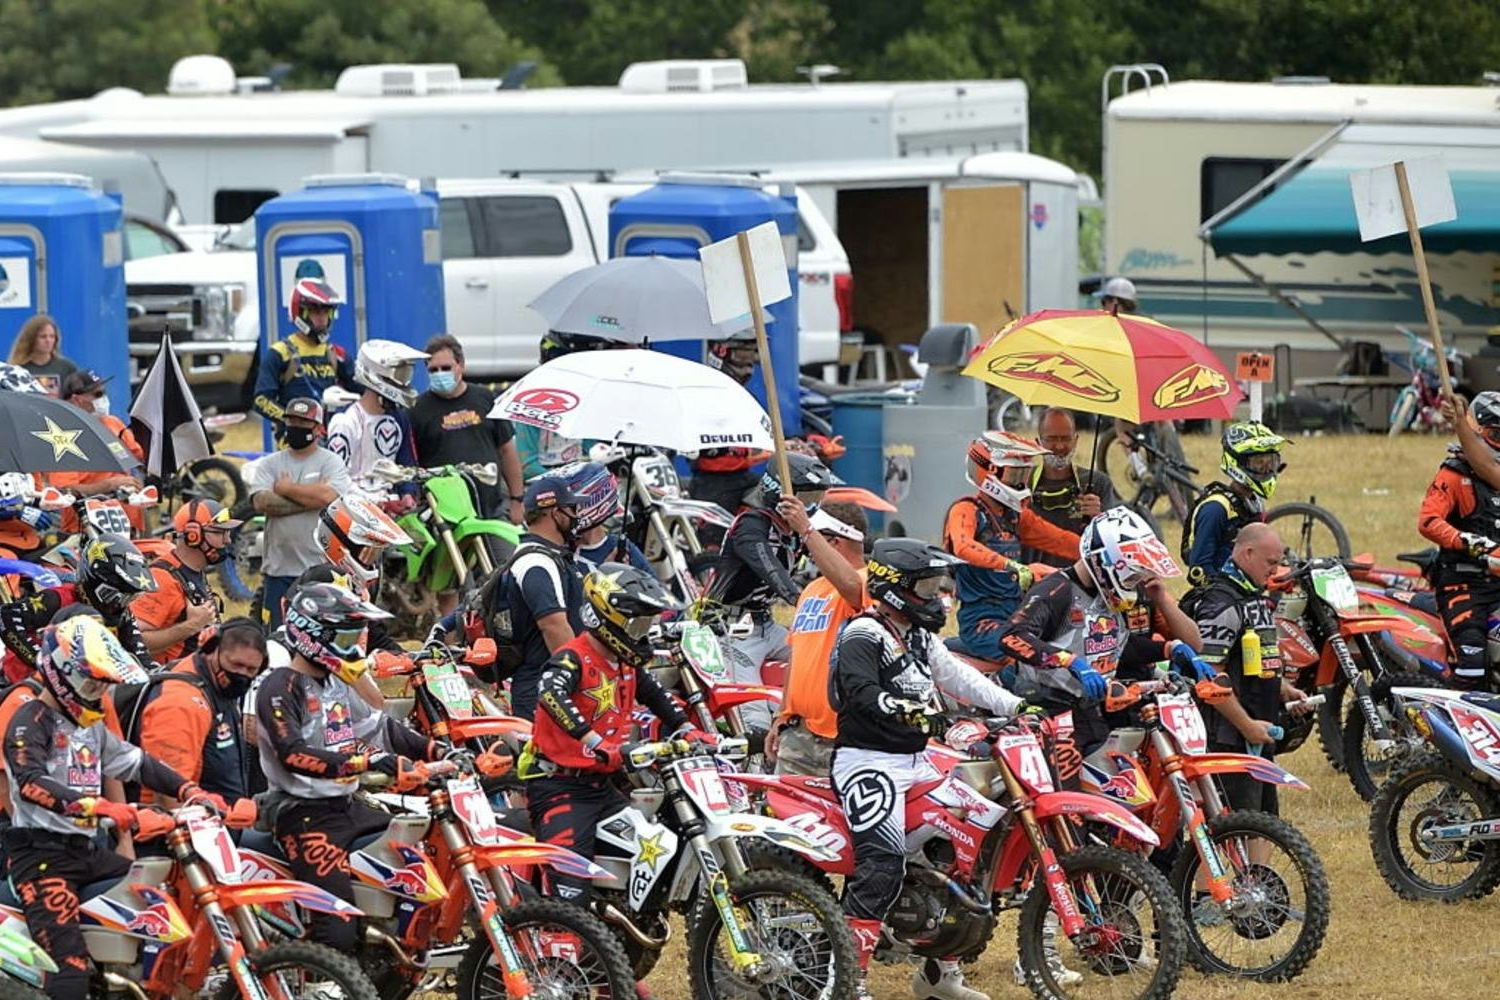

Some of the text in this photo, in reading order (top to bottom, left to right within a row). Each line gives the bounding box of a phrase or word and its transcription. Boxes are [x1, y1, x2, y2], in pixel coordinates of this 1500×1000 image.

[999, 354, 1116, 399] FMF
[1241, 356, 1270, 369] OPEN
[1156, 365, 1228, 409] FMF
[211, 830, 237, 874] 1
[933, 816, 976, 848] HONDA
